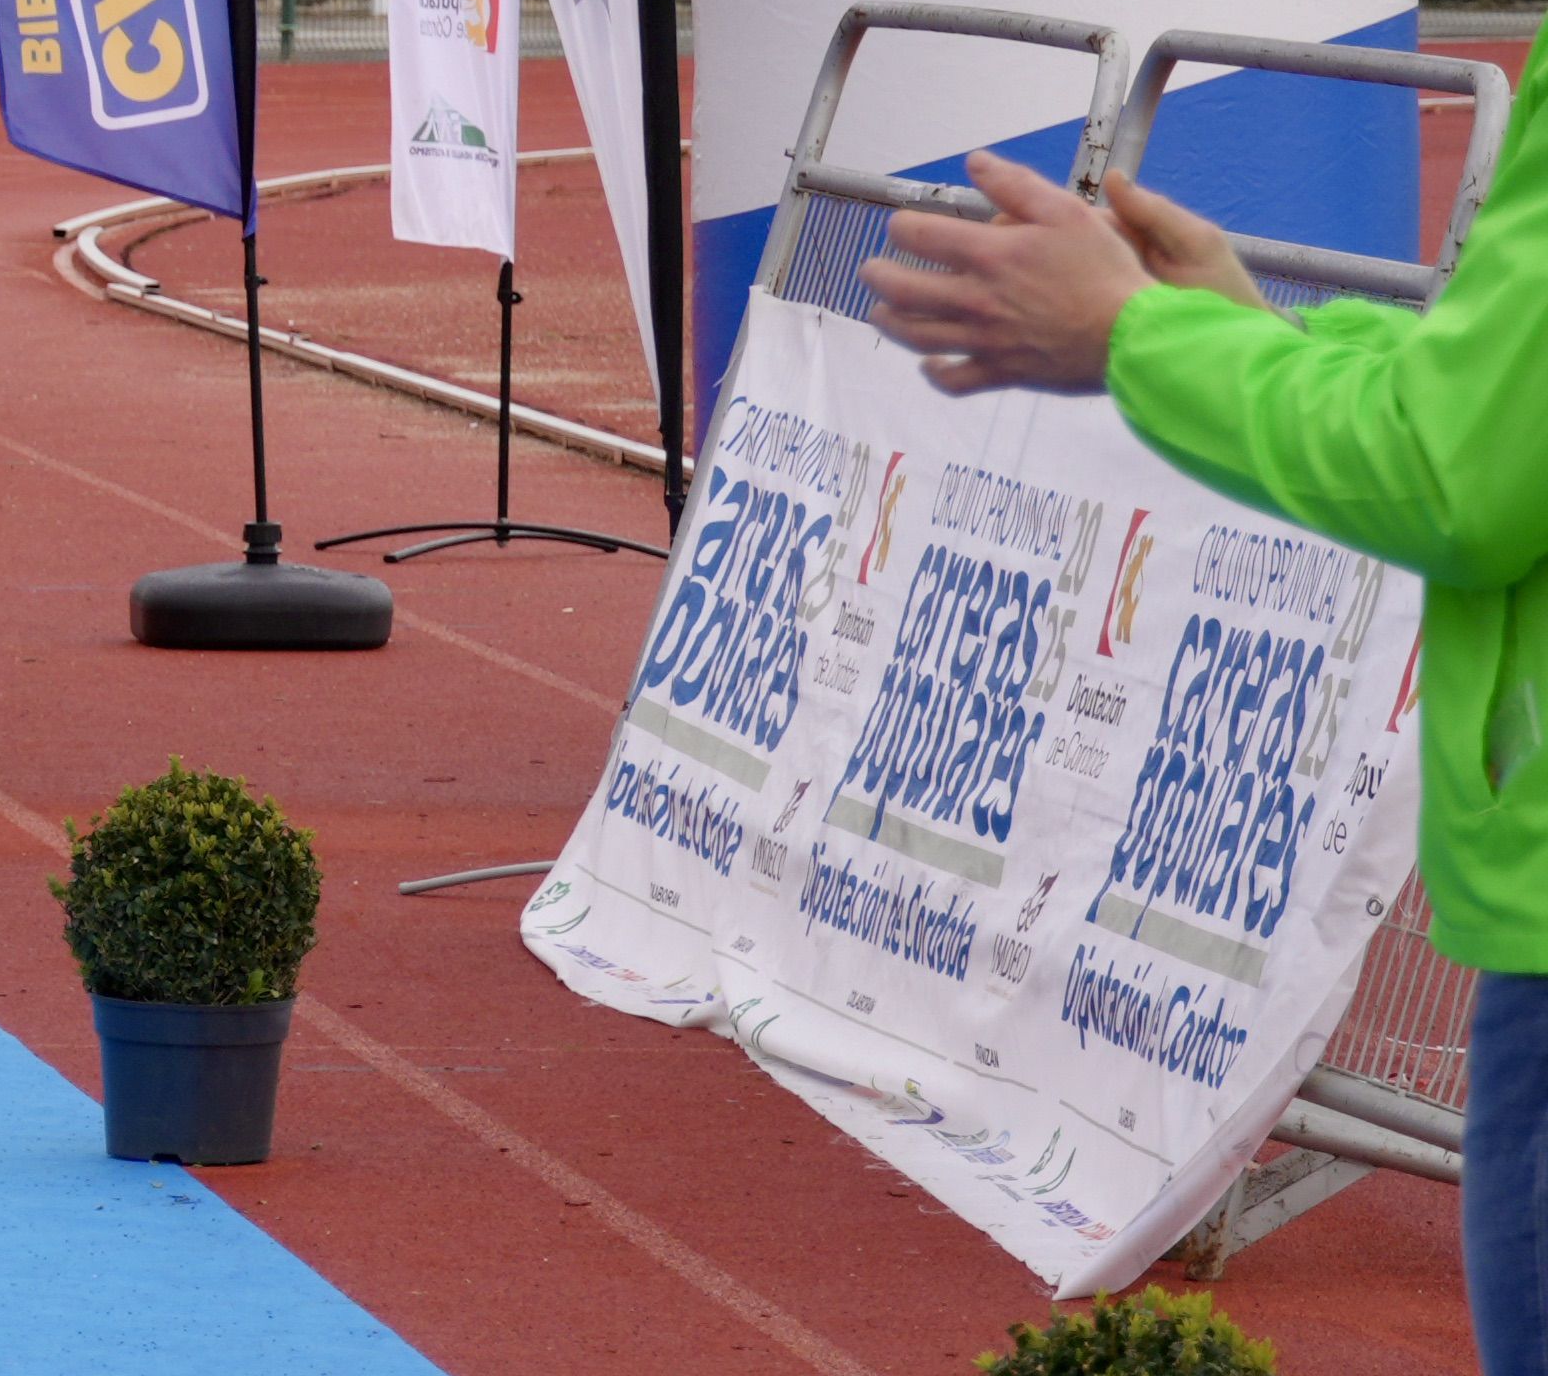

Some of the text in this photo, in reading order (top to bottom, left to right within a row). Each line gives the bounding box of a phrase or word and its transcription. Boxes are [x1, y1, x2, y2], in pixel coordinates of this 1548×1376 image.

[931, 461, 1072, 561] CIRCUITO PROVINCIAL
[1056, 497, 1104, 597] 20
[893, 543, 1052, 712] carreras
[1192, 523, 1350, 625] CIRCUITO PROVINCIAL
[1330, 555, 1386, 664] 20
[1024, 604, 1077, 703] 25
[1066, 673, 1127, 728] Diputación
[1155, 612, 1325, 788] carreras
[822, 663, 1046, 844] populares
[1044, 730, 1110, 780] de Córdoba
[1294, 673, 1352, 782] 25
[1084, 744, 1317, 941] populares
[1321, 814, 1347, 855] de
[799, 841, 977, 983] Diputación de Córdoba
[1060, 943, 1154, 1063] Diputación
